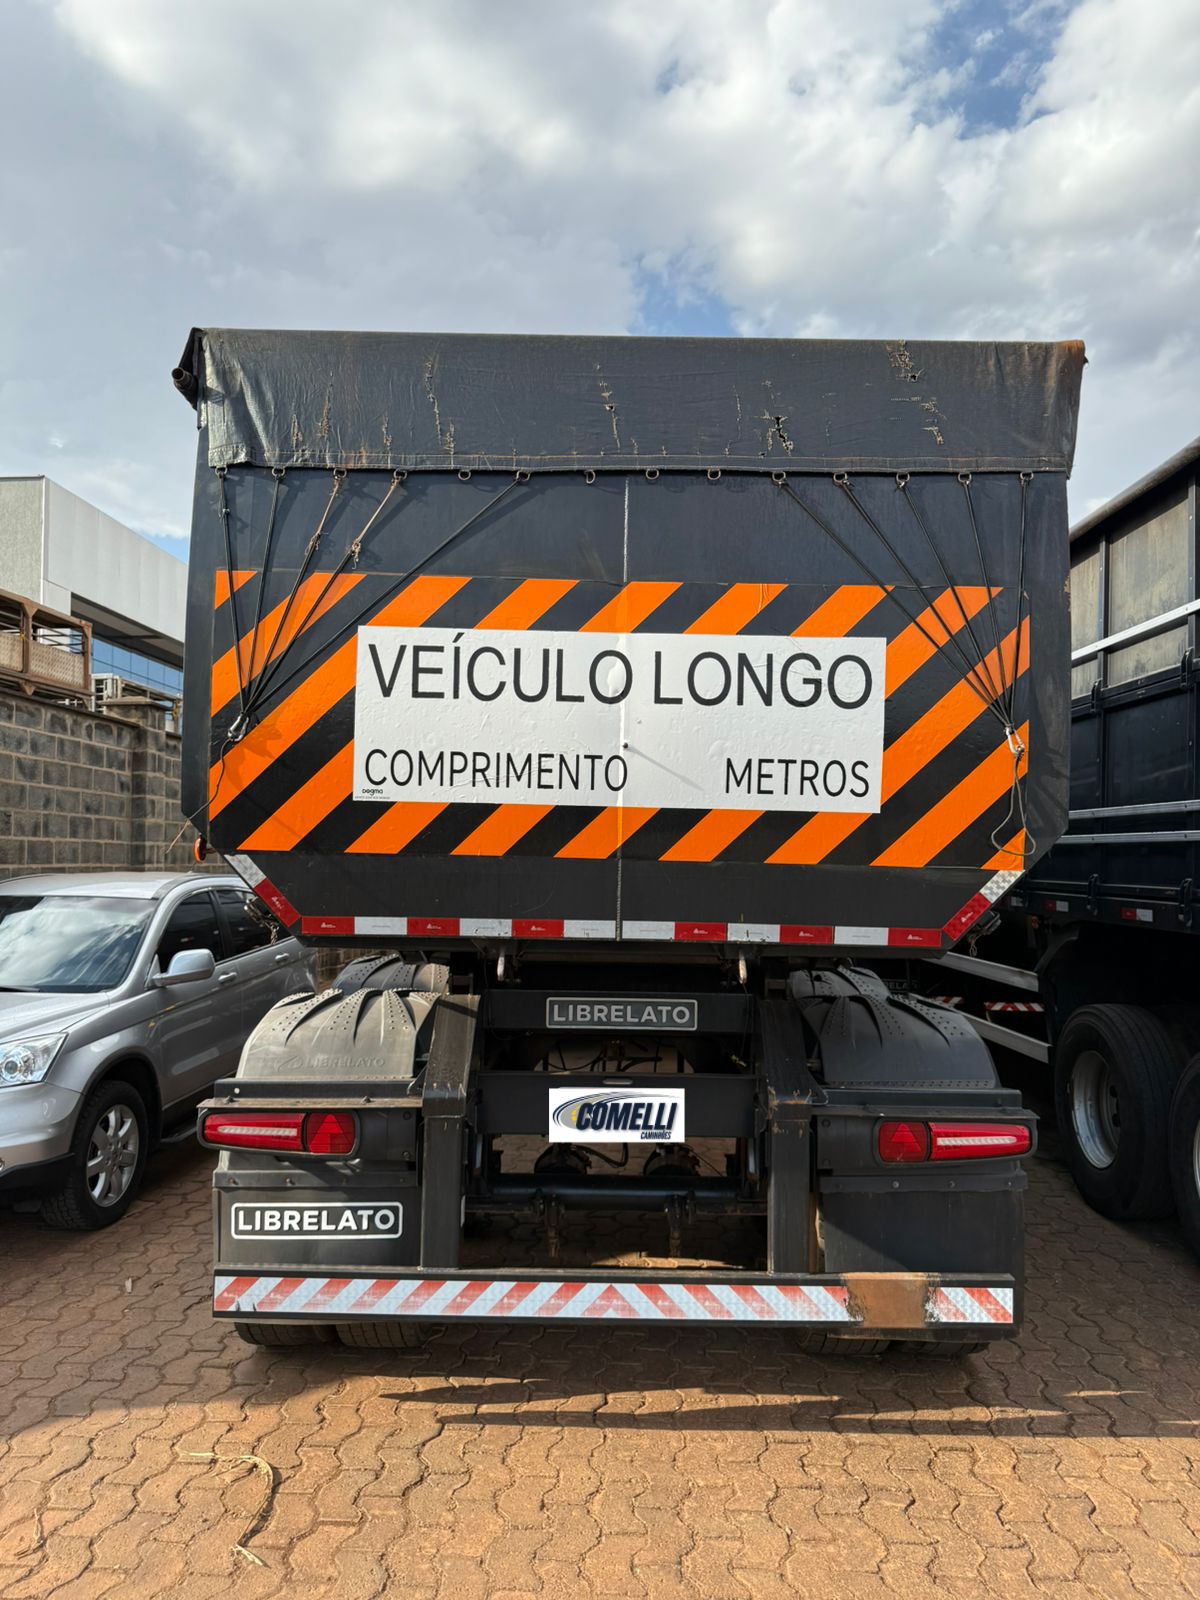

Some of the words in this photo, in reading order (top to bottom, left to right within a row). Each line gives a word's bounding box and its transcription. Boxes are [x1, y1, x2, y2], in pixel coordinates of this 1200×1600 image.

[367, 631, 634, 705] VEÍCULO
[654, 650, 873, 710] LONGO
[364, 748, 629, 792] COMPRIMENTO
[725, 757, 870, 798] METROS
[553, 1004, 691, 1024] LIBRELATO
[303, 1055, 386, 1069] LIBRELATO
[238, 1209, 395, 1231] LIBRELATO
